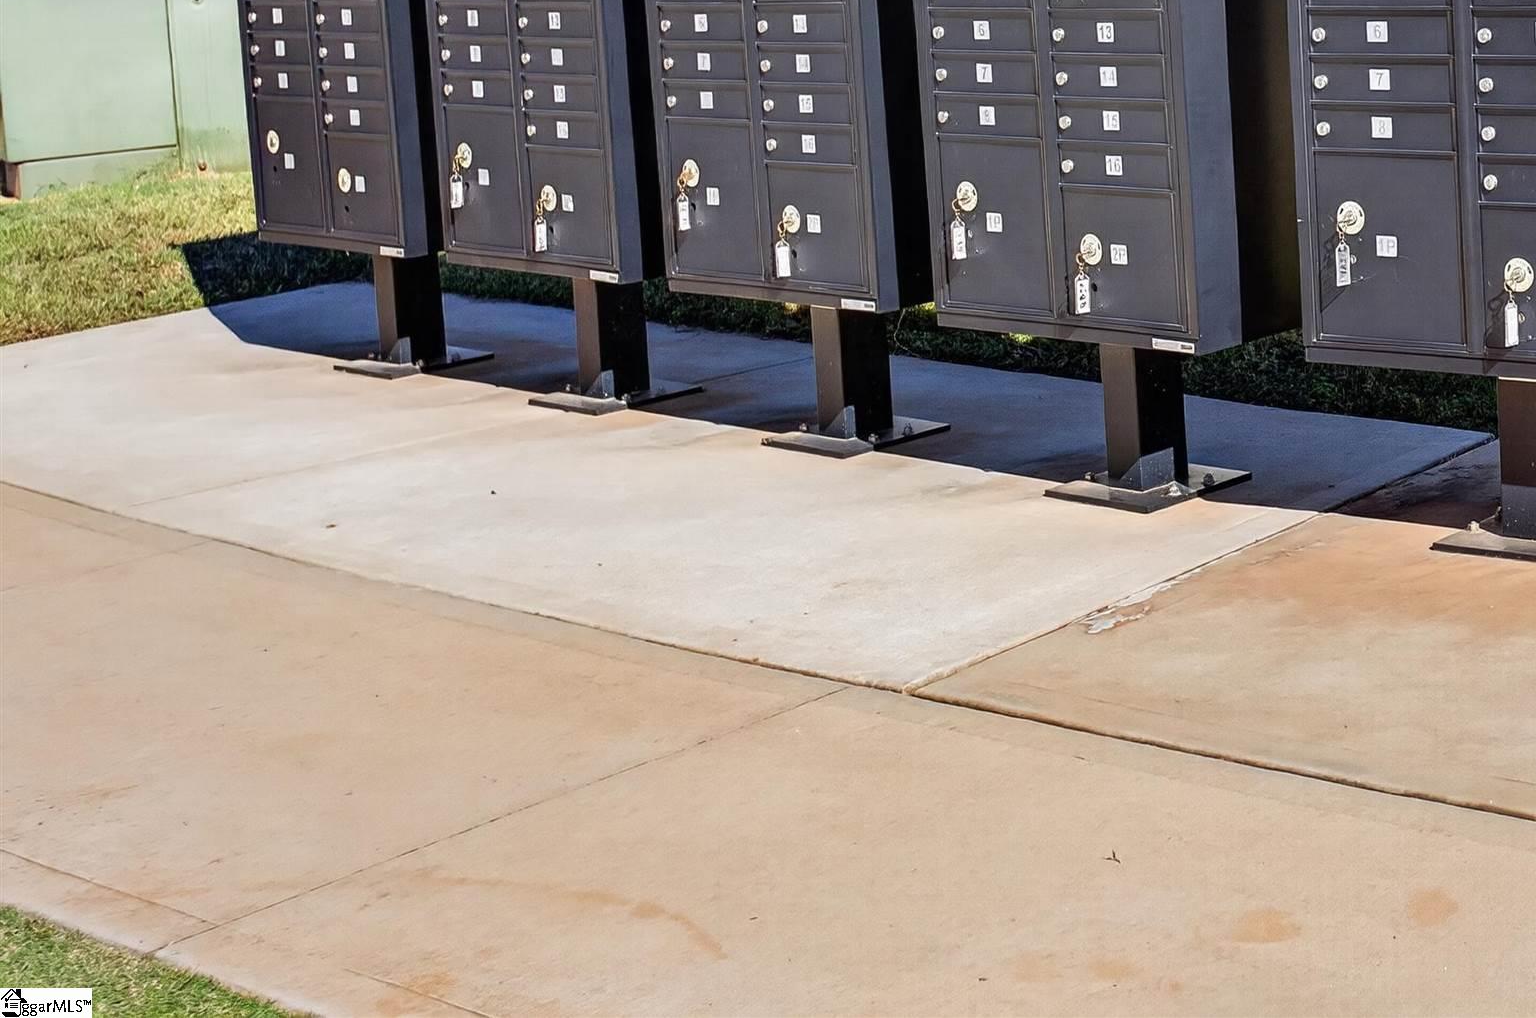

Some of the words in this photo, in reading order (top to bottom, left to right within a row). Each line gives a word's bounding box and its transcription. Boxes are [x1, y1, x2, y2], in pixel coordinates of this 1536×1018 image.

[1374, 24, 1381, 39] 6
[1375, 73, 1384, 87] 7
[1378, 120, 1386, 134] 8
[1379, 238, 1396, 255] 1P
